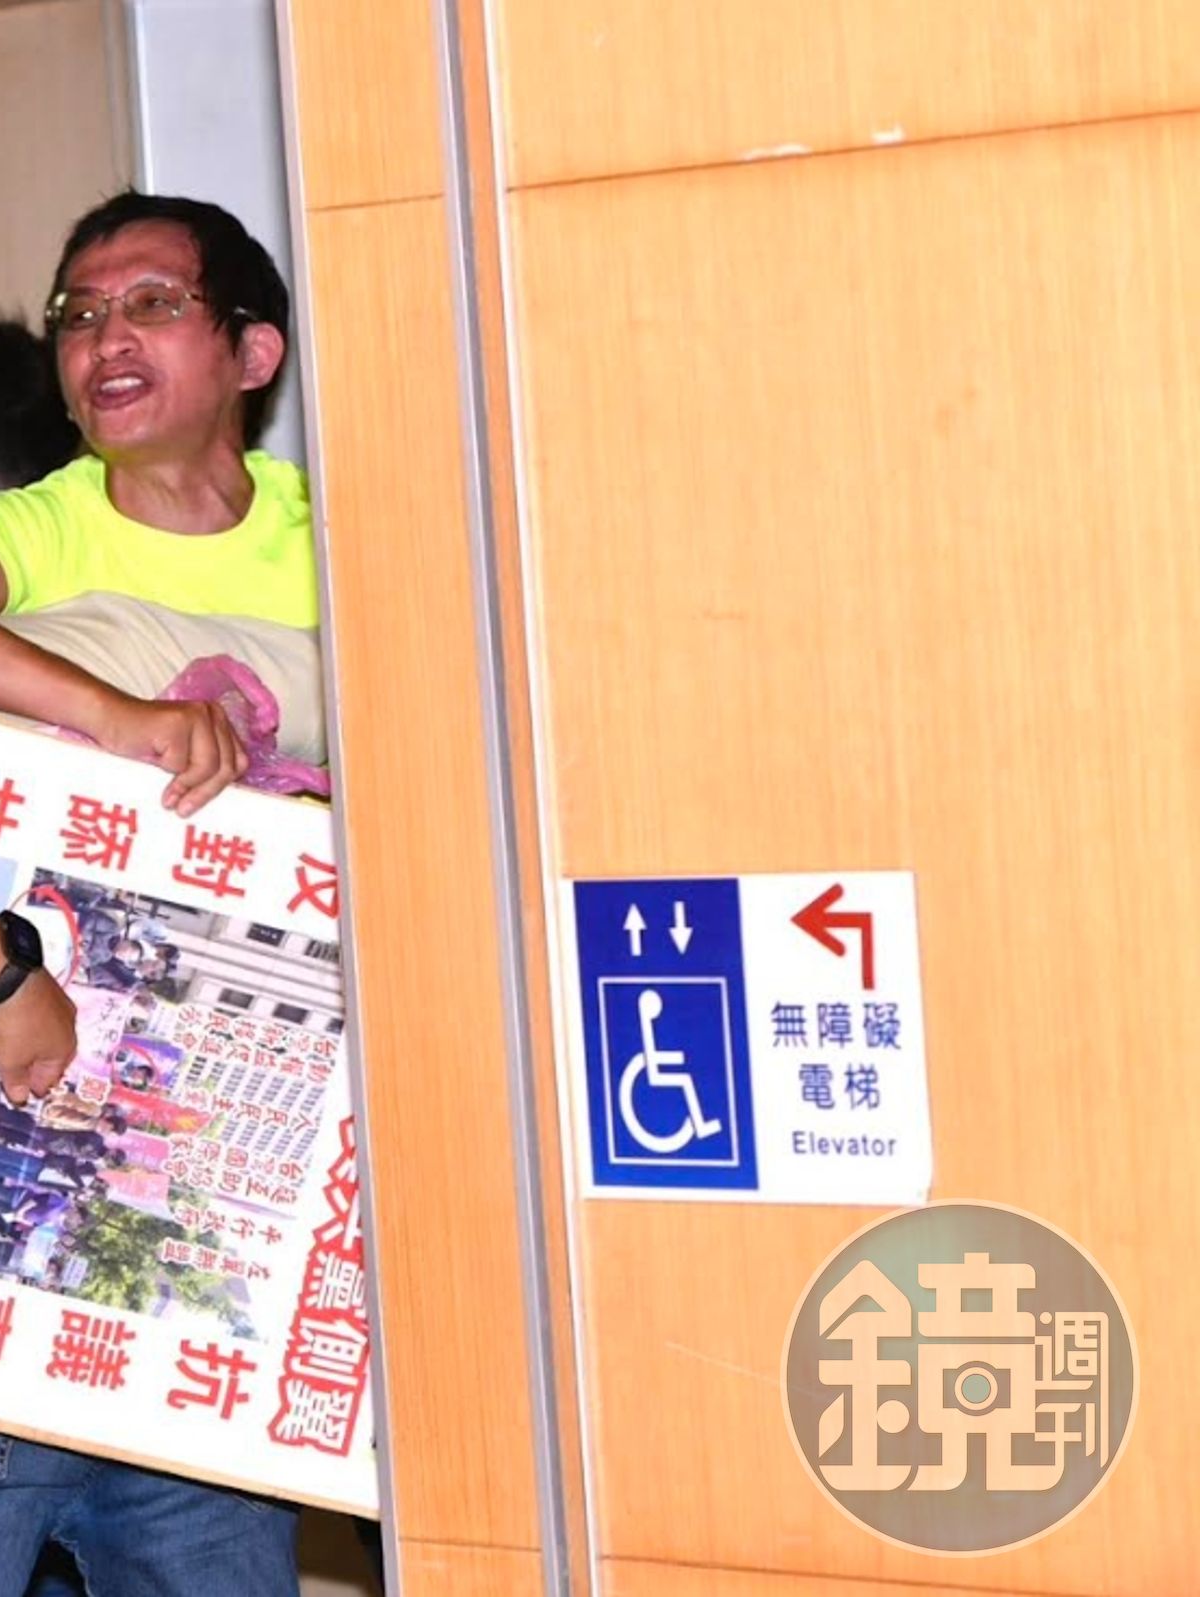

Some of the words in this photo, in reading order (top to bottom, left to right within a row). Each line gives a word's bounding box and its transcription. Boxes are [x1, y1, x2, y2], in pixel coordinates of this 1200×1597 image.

[770, 1001, 902, 1050] 無障礙
[799, 1063, 881, 1111] 電梯
[792, 1130, 898, 1157] Elevator
